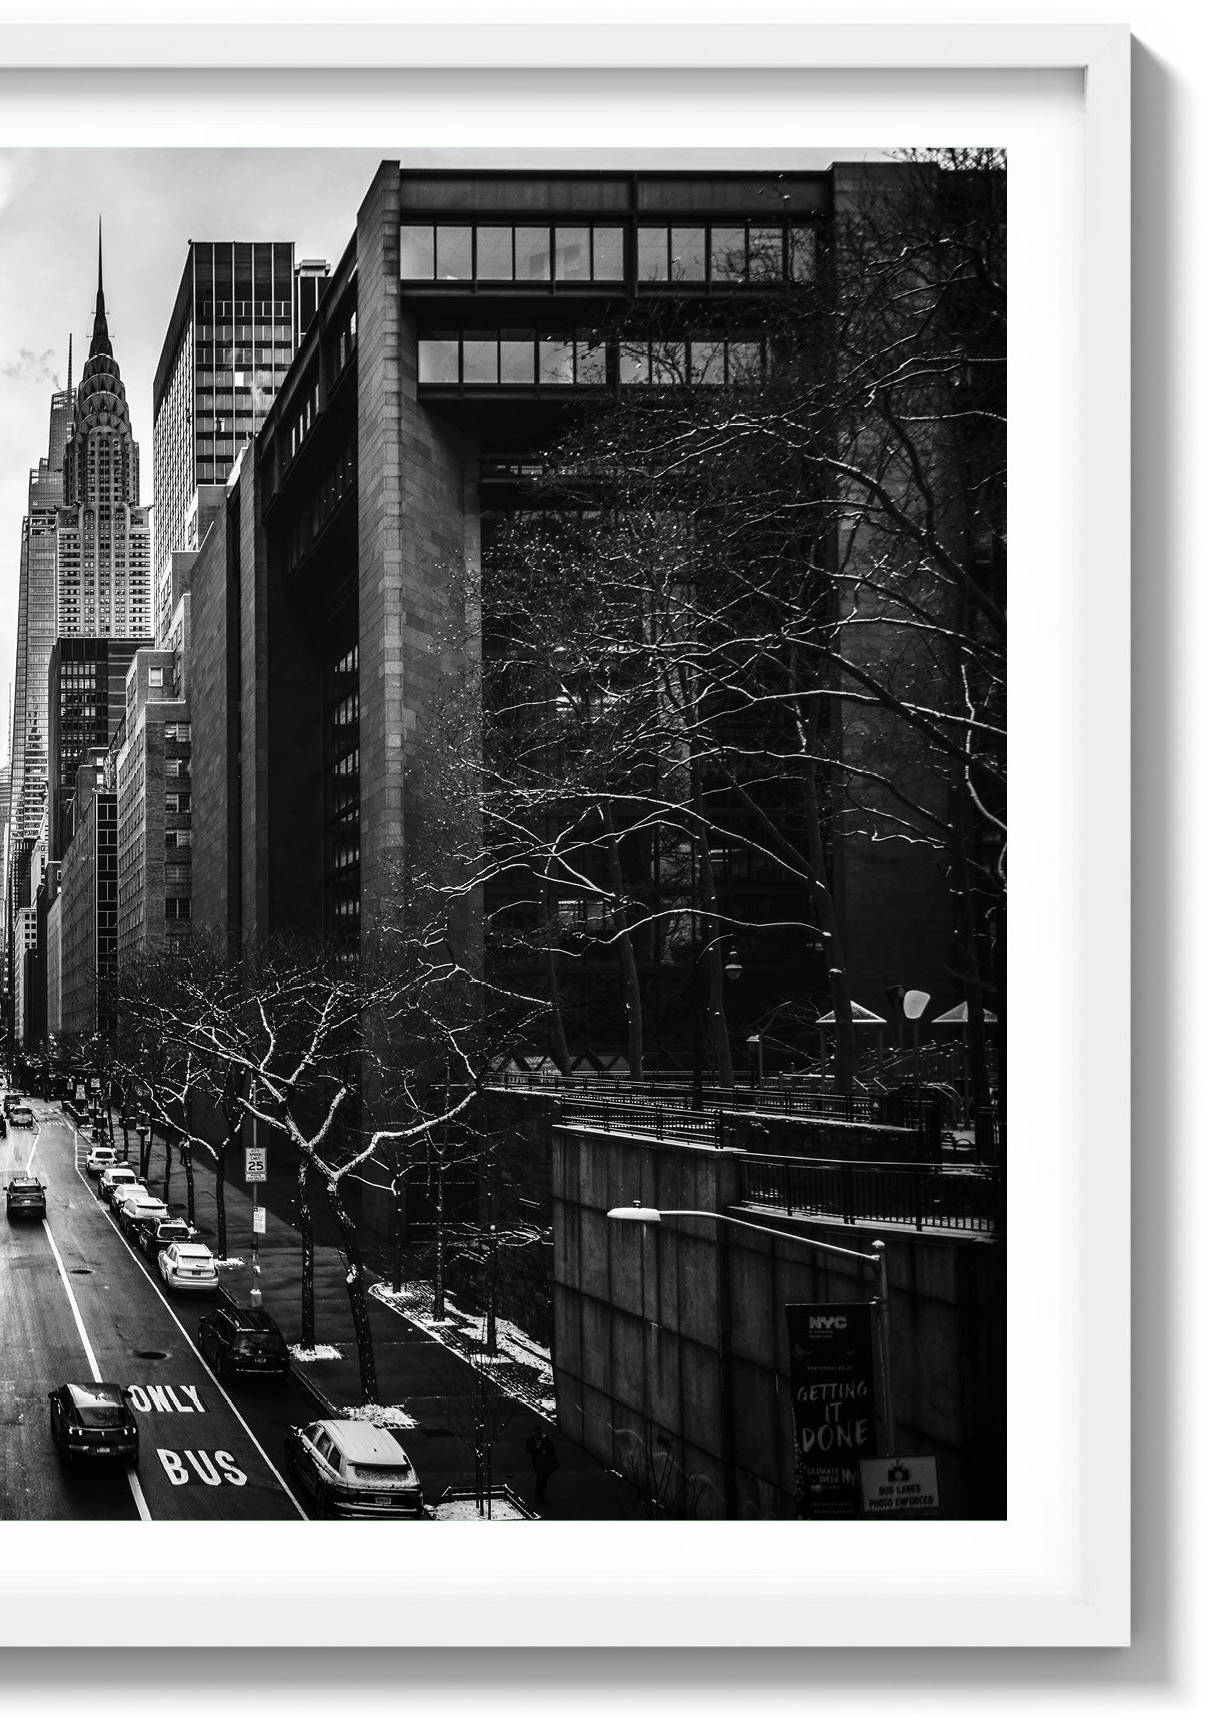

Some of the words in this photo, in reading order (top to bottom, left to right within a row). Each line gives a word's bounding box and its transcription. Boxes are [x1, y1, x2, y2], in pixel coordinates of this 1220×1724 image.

[248, 1161, 264, 1171] 25
[809, 1316, 847, 1329] NYC
[797, 1380, 868, 1401] GETTING
[127, 1384, 206, 1413] ONLY
[825, 1402, 842, 1423] IT
[801, 1417, 869, 1454] DONE
[156, 1448, 248, 1486] BUS
[806, 1467, 840, 1475] CLIMATE
[818, 1475, 840, 1484] WEEK
[879, 1486, 894, 1496] BUS
[896, 1484, 922, 1494] LANES
[869, 1498, 894, 1508] PHOTO
[895, 1496, 934, 1507] ENFORCED
